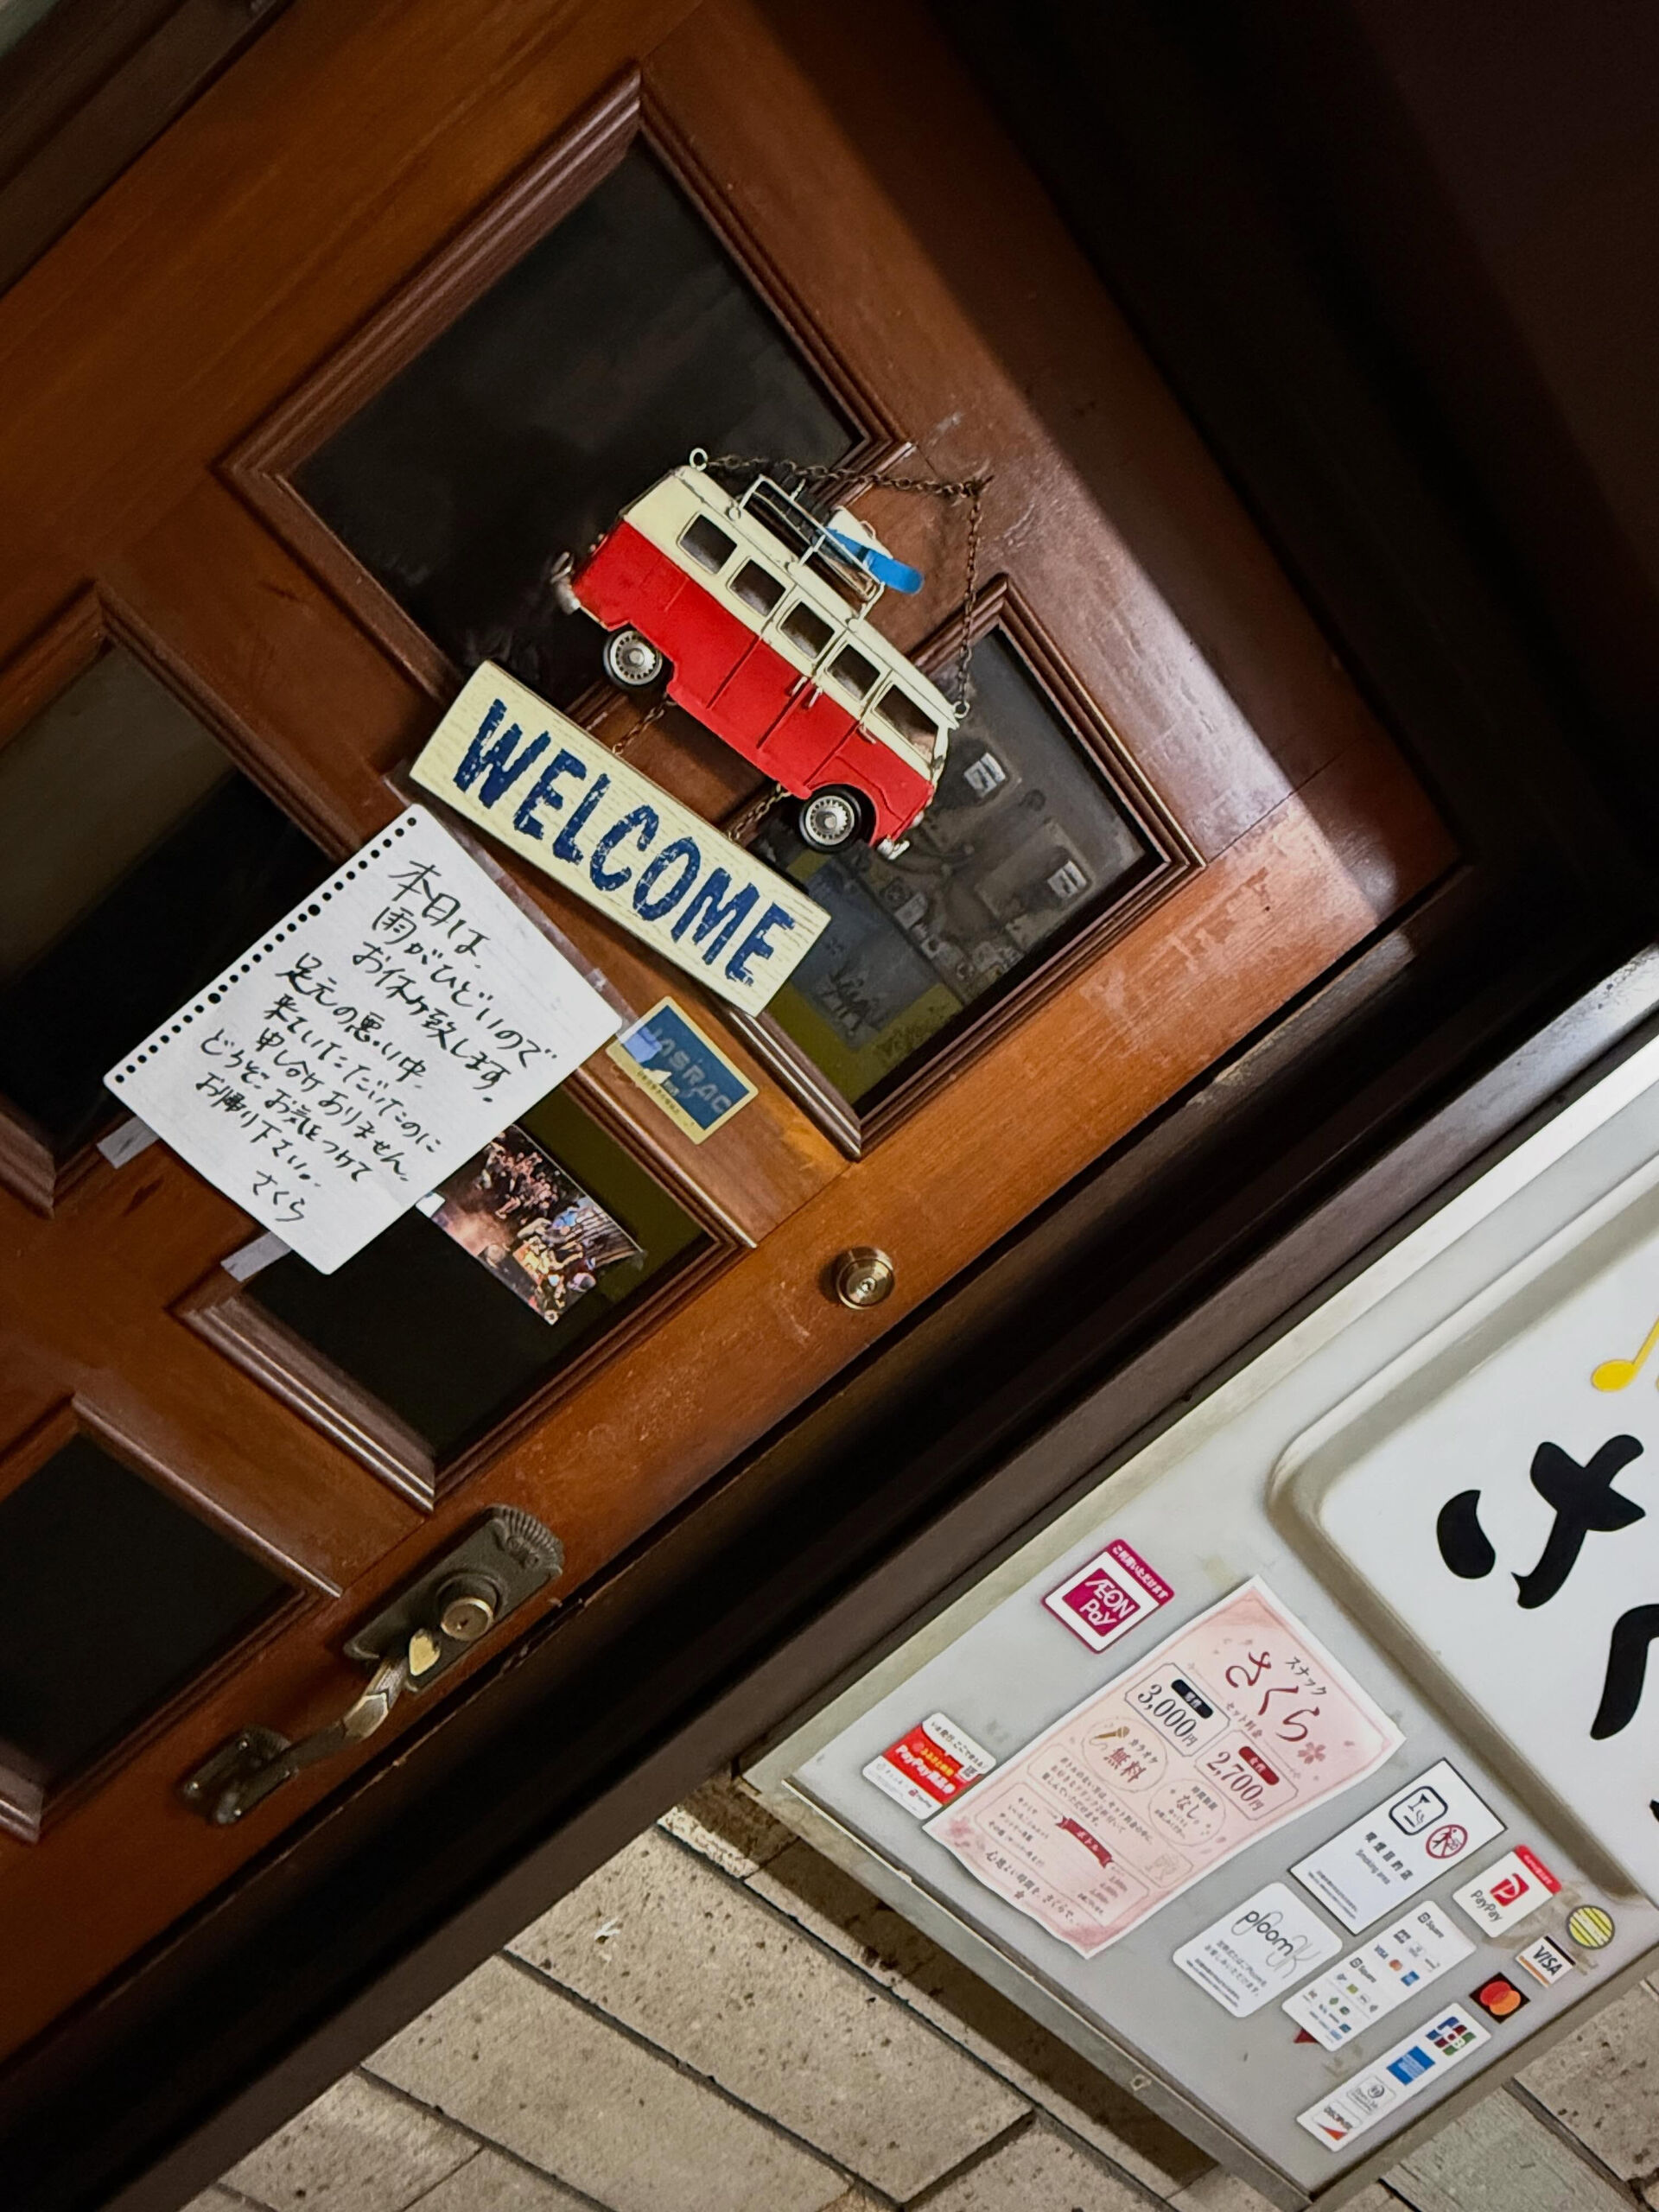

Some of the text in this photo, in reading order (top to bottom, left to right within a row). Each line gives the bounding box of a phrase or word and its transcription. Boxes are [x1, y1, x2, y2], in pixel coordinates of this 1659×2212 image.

[452, 697, 795, 988] WELCOME
[238, 1165, 313, 1230] さくら
[1224, 1649, 1322, 1744] さくら
[1282, 1654, 1330, 1700] スナック
[1135, 1683, 1202, 1749] 3,000円
[1101, 1745, 1148, 1783] 無料
[1128, 1738, 1160, 1765] カラオケ
[1205, 1751, 1268, 1812] 2,700円
[1353, 1848, 1391, 1885] Smoking area
[1467, 1888, 1505, 1924] PayPay
[1425, 1920, 1445, 1939] Square
[1532, 1944, 1563, 1977] VISA
